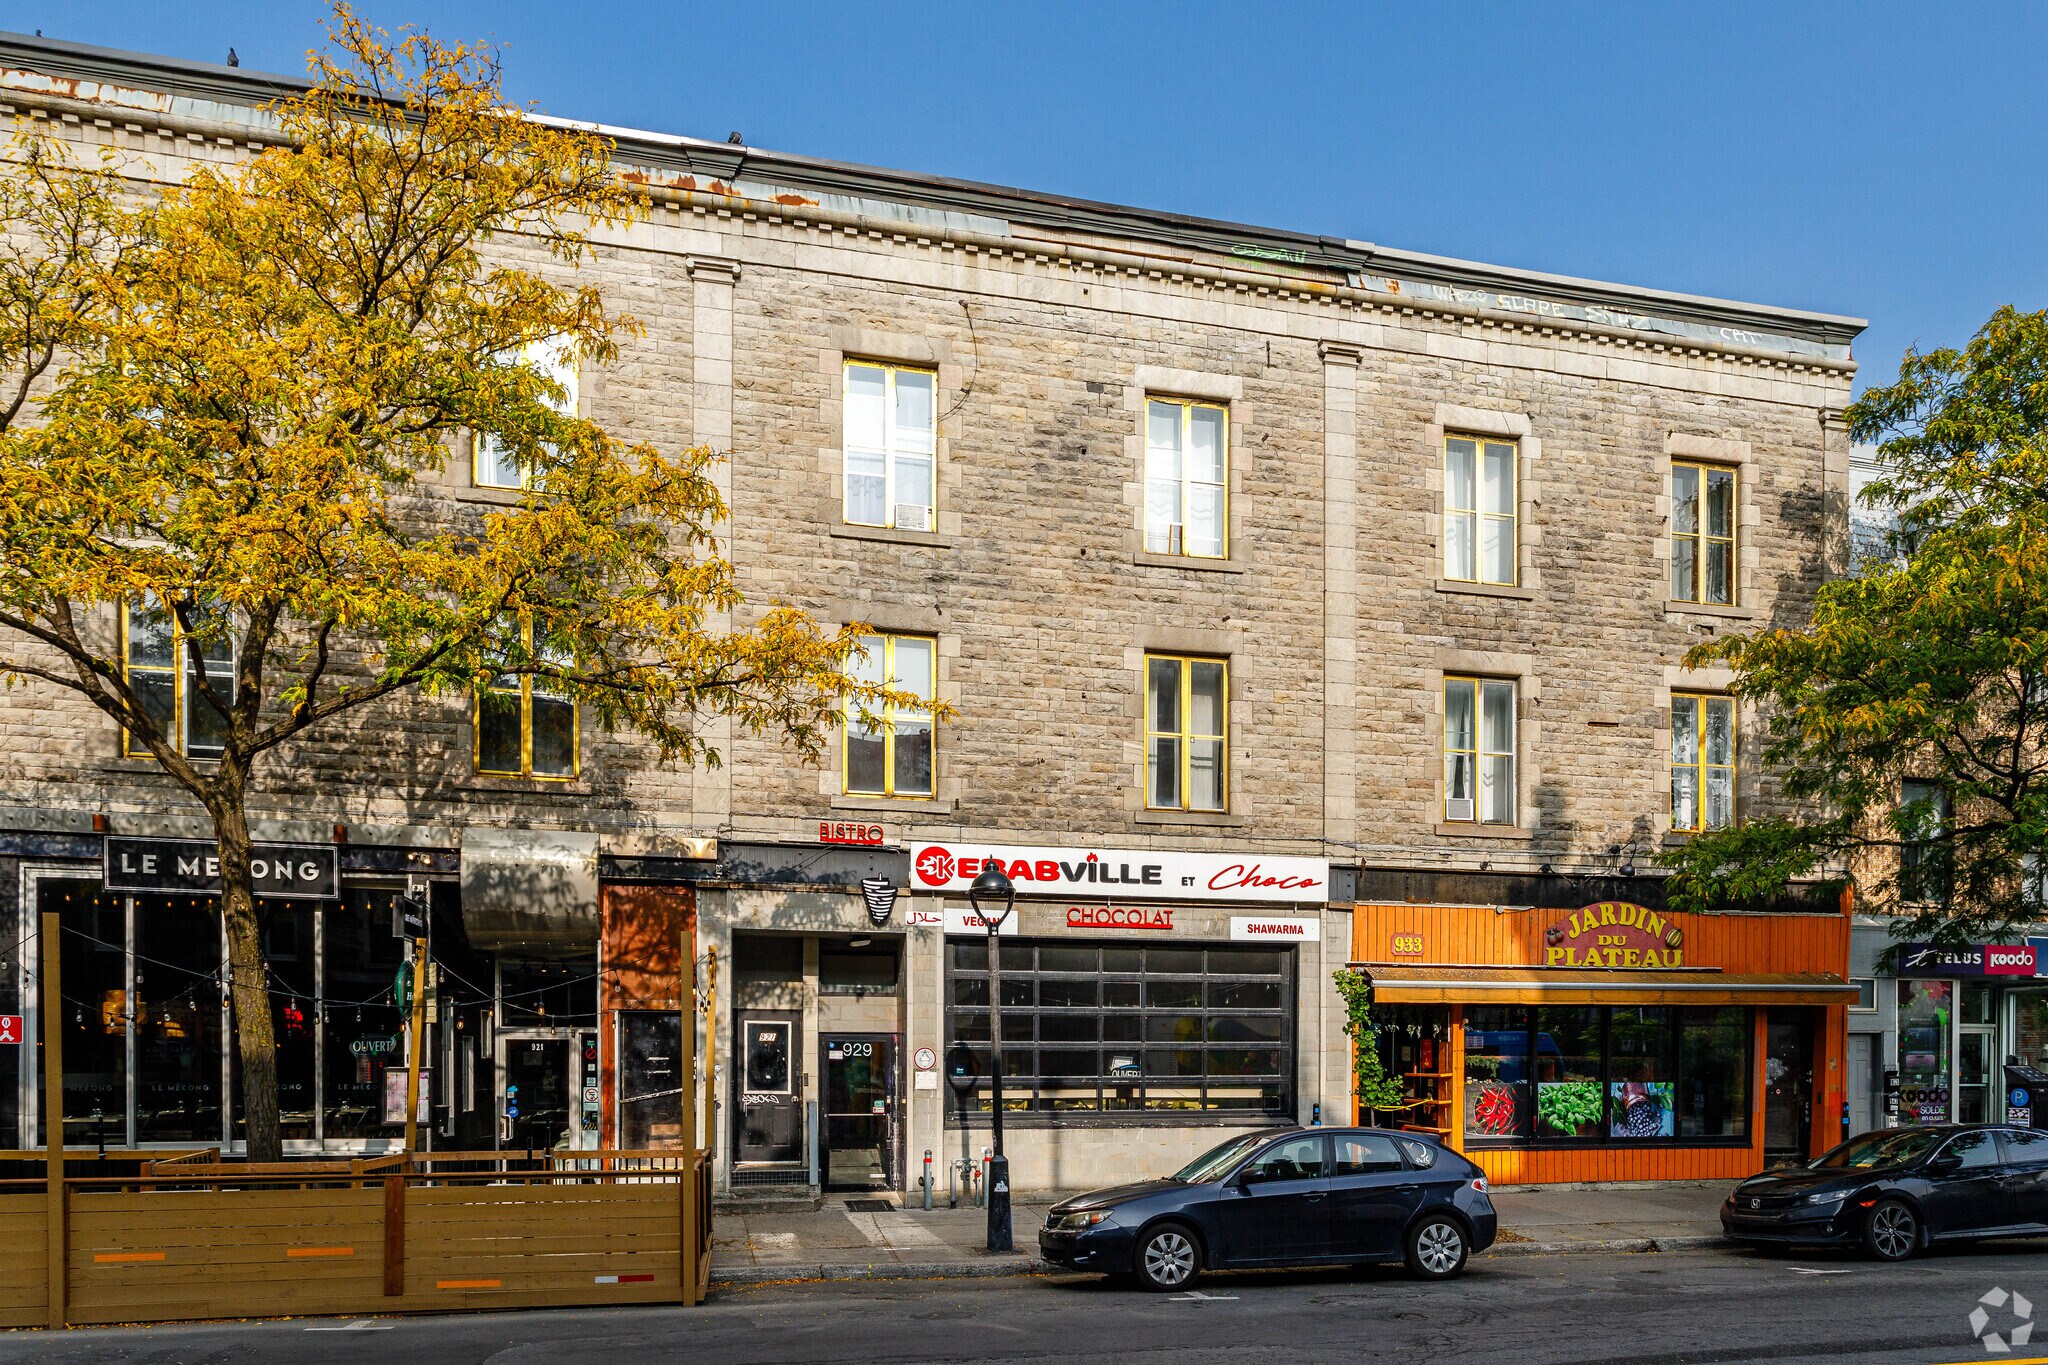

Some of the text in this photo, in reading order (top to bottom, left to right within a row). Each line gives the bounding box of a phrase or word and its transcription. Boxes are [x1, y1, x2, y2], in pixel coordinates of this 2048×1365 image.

[819, 821, 884, 843] BISTRO
[121, 853, 320, 882] LE MEONG
[1181, 876, 1195, 887] ET
[1207, 863, 1323, 891] Choco
[1066, 906, 1174, 928] CHOCOLAT
[1567, 902, 1667, 939] JARDIN
[1246, 923, 1304, 935] SHAWARMA
[1394, 936, 1423, 952] 933
[1597, 934, 1628, 946] DU
[1546, 946, 1683, 968] PLATEAU
[352, 1040, 391, 1052] OUVERT
[531, 1043, 544, 1051] 921
[842, 1043, 873, 1057] 929
